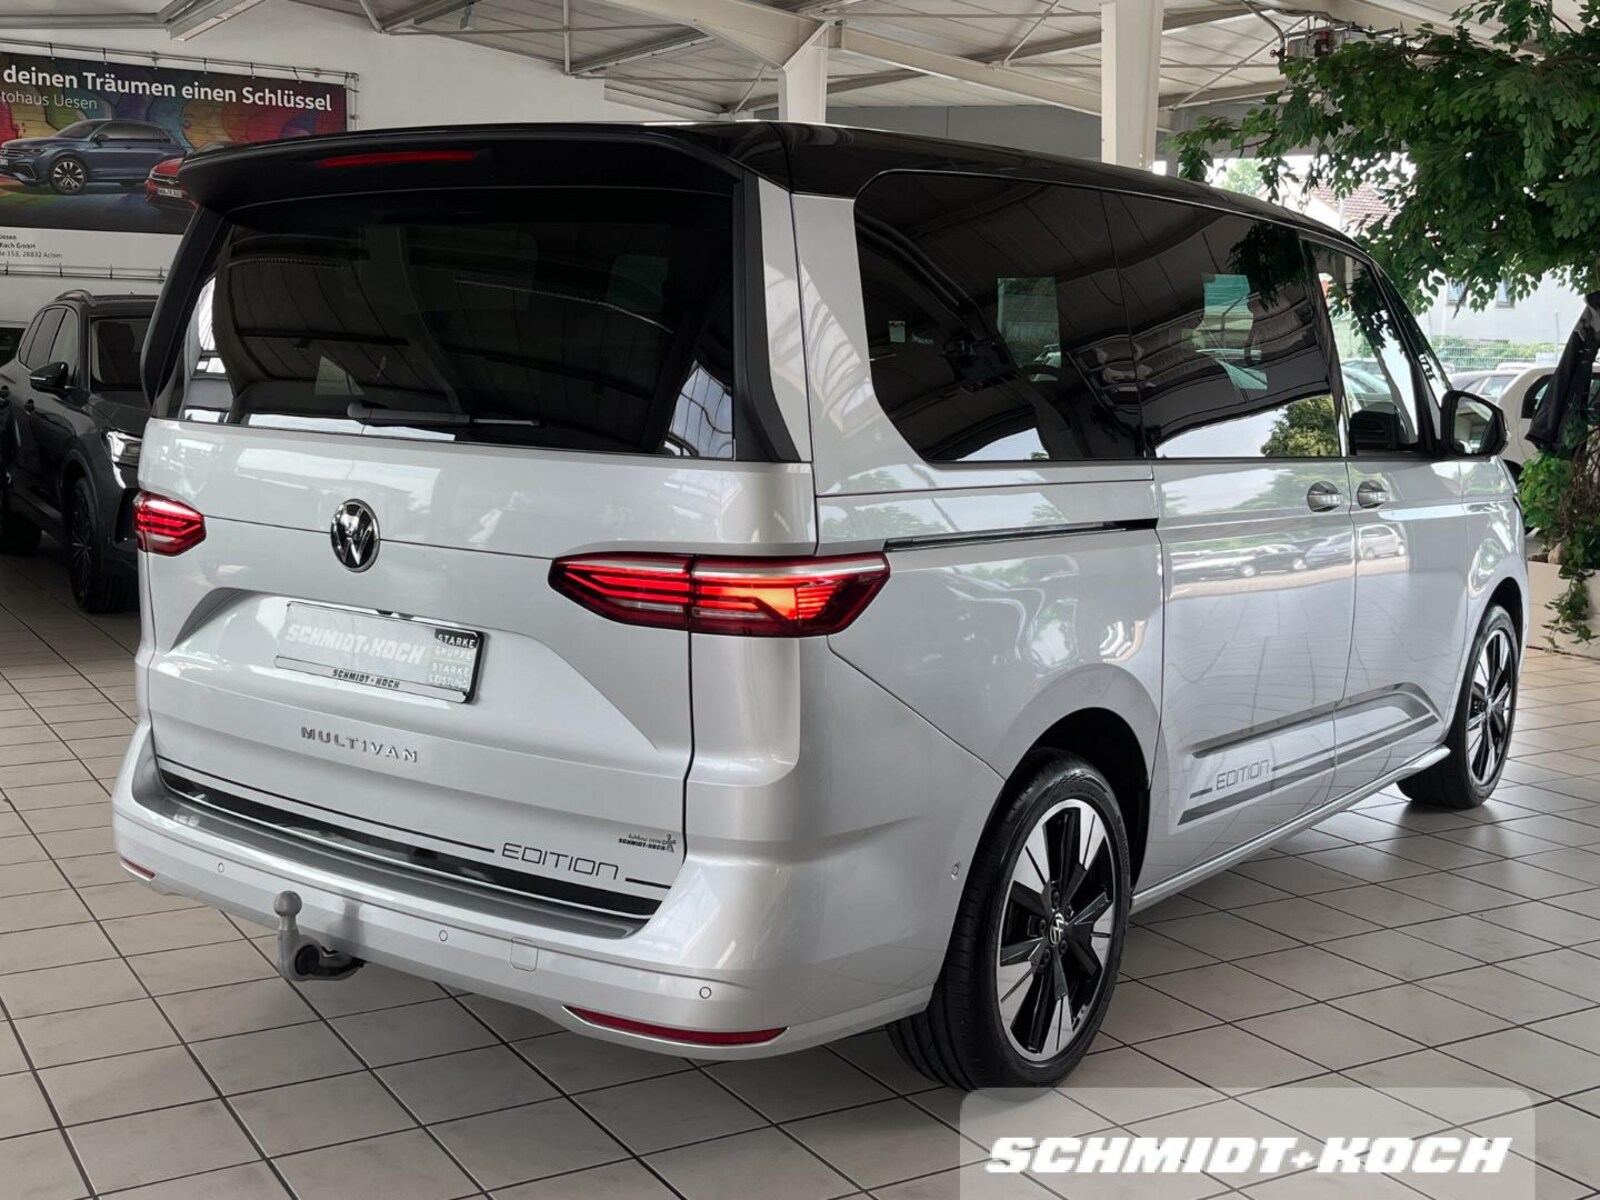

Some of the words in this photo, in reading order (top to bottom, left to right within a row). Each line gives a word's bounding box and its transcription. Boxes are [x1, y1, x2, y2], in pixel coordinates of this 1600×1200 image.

[3, 65, 78, 89] deinen
[83, 72, 176, 97] Träumen
[181, 81, 236, 103] einen
[242, 87, 332, 111] Schlüssel
[53, 95, 98, 110] Uesen
[438, 634, 476, 649] STARKE
[301, 726, 418, 762] MULTIVAN
[1216, 759, 1270, 790] EDITION
[502, 842, 619, 880] EDITION
